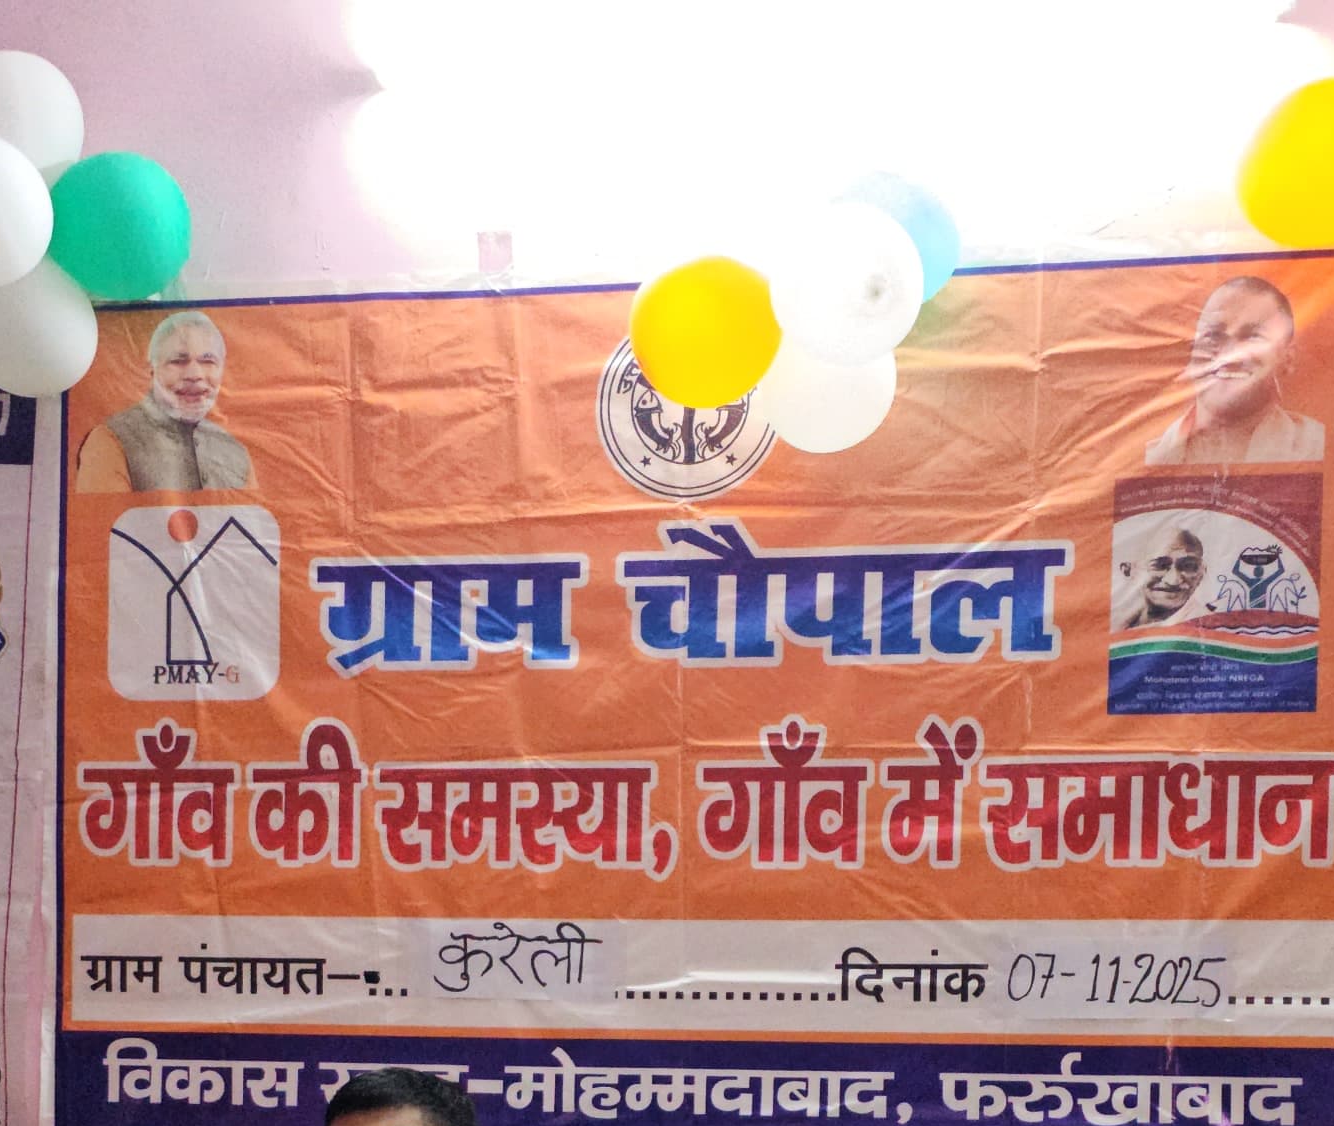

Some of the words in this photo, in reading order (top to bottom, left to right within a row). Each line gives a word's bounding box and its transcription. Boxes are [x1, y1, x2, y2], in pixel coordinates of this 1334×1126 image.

[316, 562, 580, 671] ग्राम
[623, 522, 1066, 660] चौपाल
[153, 661, 240, 684] PMAY-G
[83, 722, 234, 862] गाँव
[252, 722, 363, 862] की
[379, 765, 673, 875] समस्या,
[702, 720, 867, 864] गाँव
[886, 721, 979, 864] में
[81, 954, 163, 995] ग्राम
[835, 946, 988, 1004] दिनांक
[102, 1037, 304, 1108] विकास
